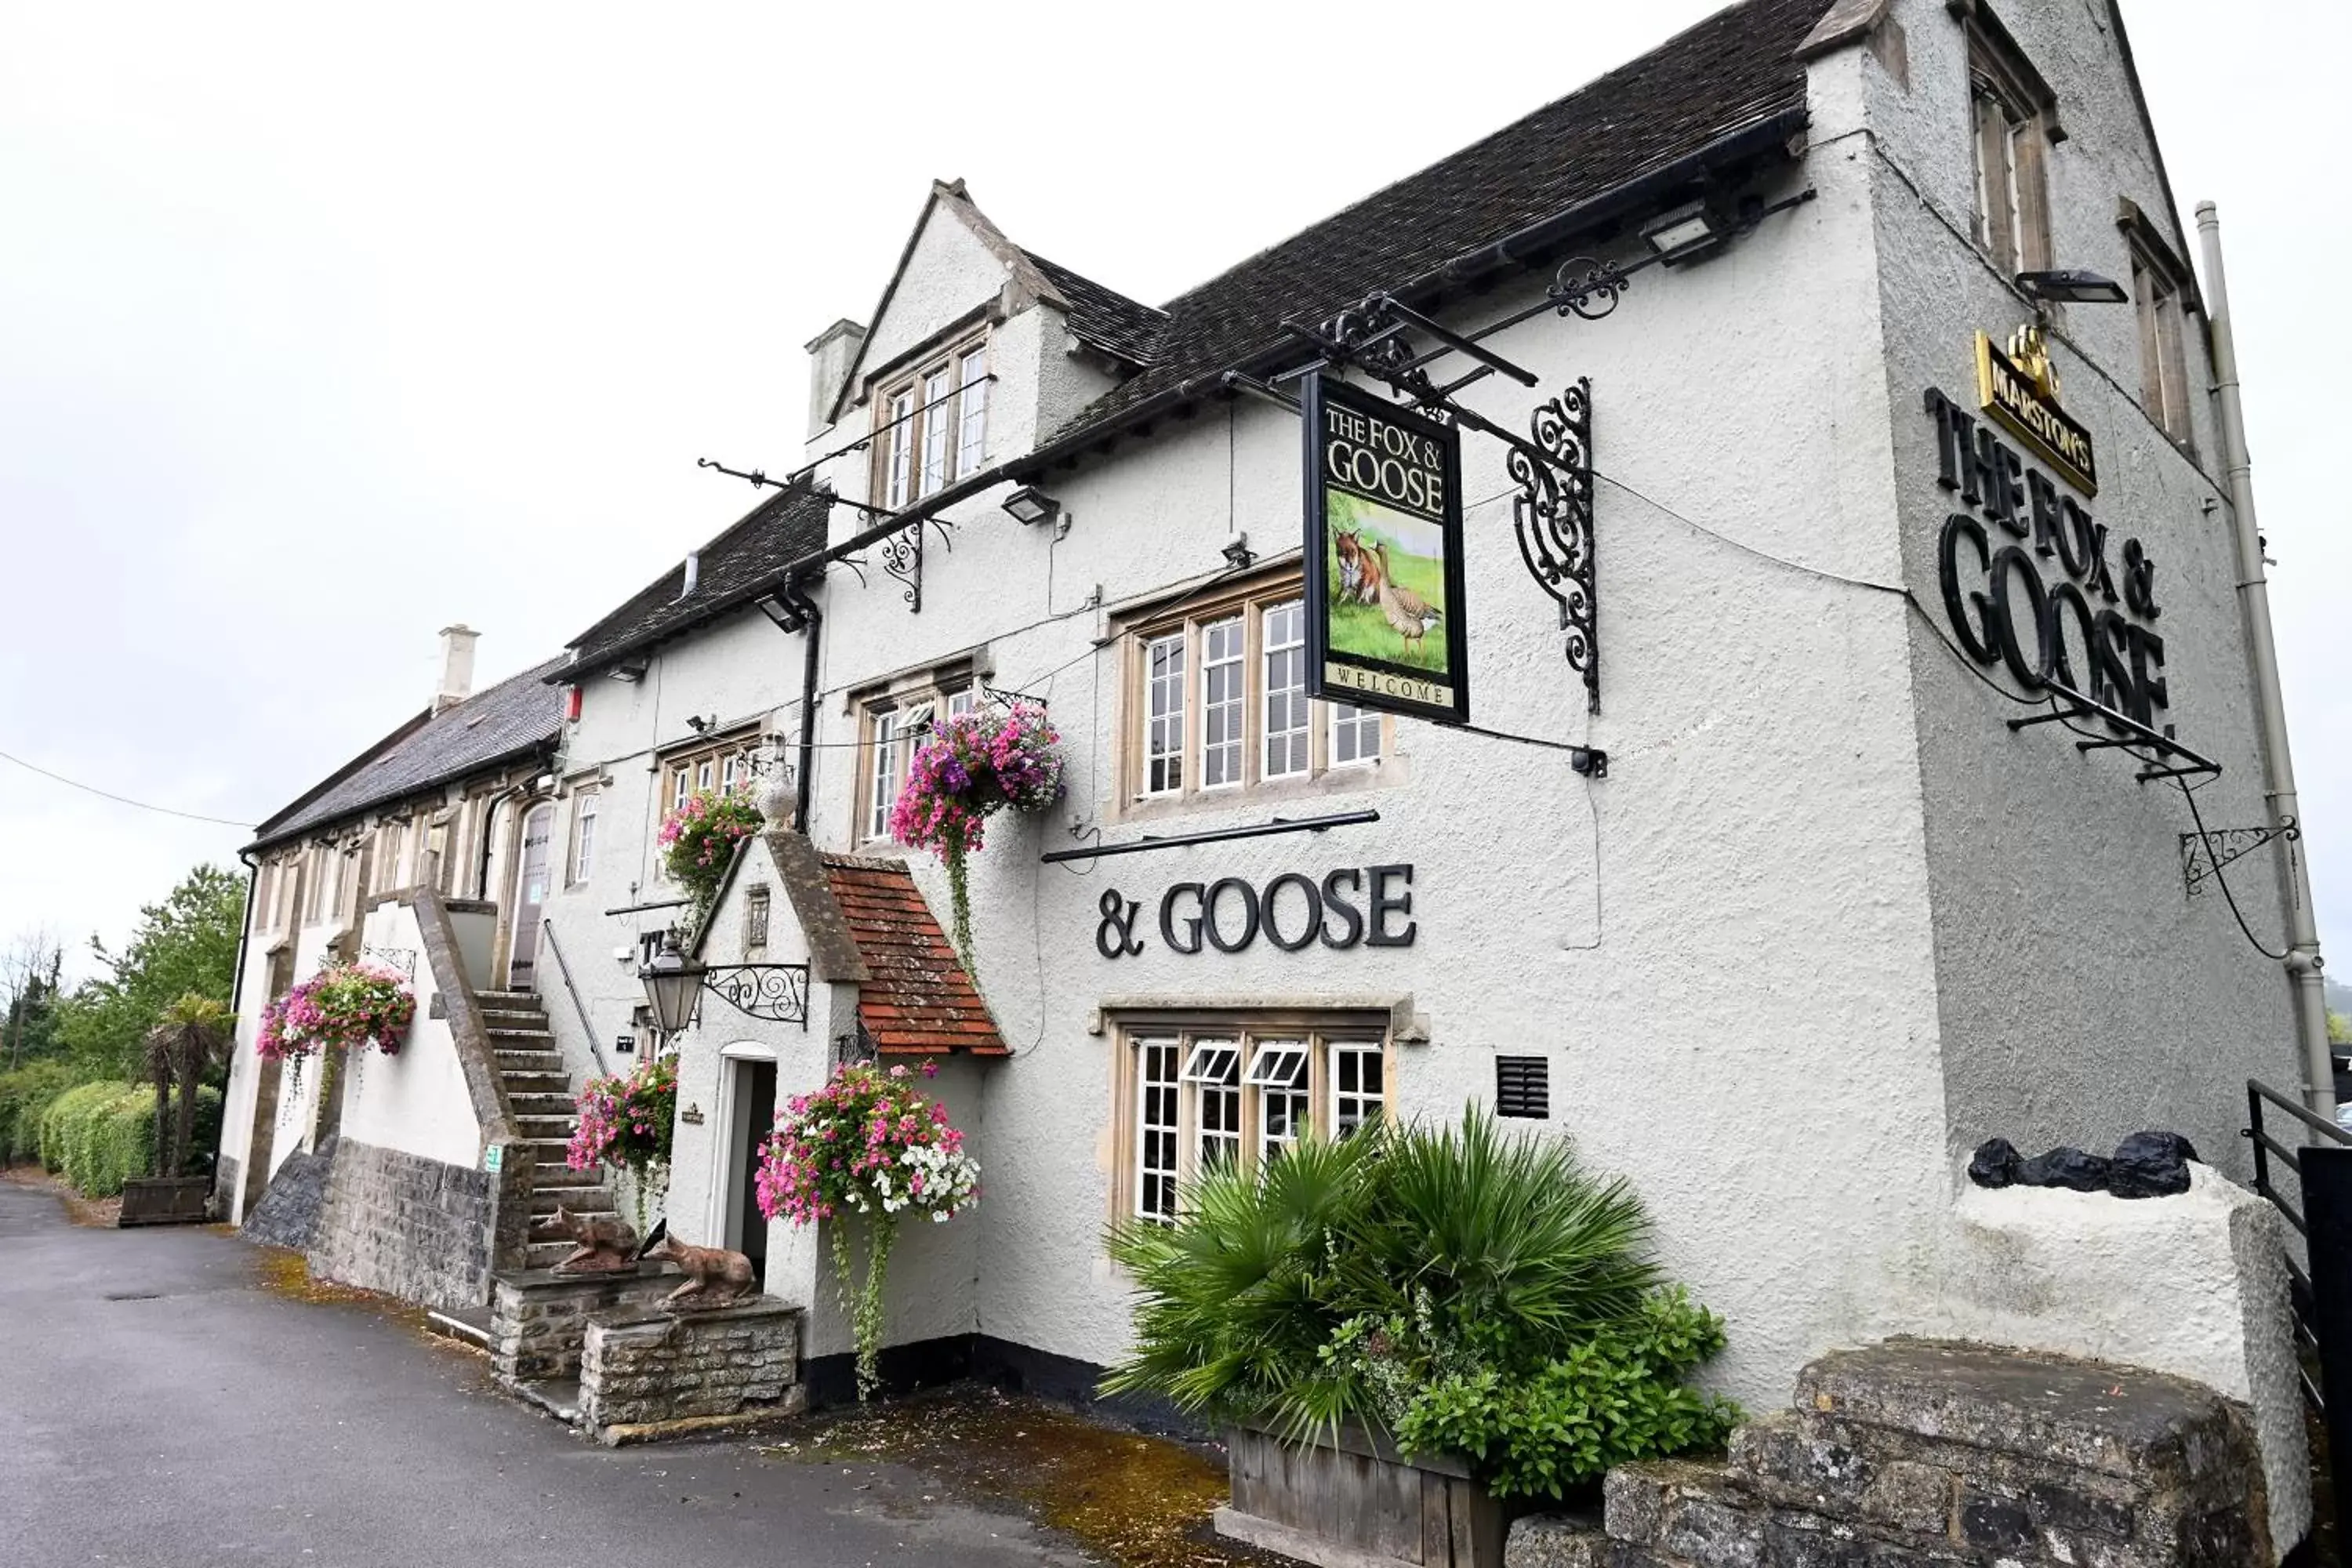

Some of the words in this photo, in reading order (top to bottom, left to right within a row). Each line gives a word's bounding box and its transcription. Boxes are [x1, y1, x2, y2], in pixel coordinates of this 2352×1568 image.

[1326, 408, 1367, 444] THE
[1368, 416, 1421, 465] FOX
[1424, 441, 1442, 471] &
[1992, 359, 2091, 473] MARSTON'S
[1327, 440, 1444, 514] GOOSE
[1924, 387, 2029, 539] THE
[2026, 466, 2119, 603] FOX
[2124, 538, 2161, 619] &
[1938, 514, 2176, 757] GOOSE
[1338, 667, 1443, 703] WELCOME
[1096, 887, 1144, 959] &
[1160, 864, 1416, 954] GOOSE
